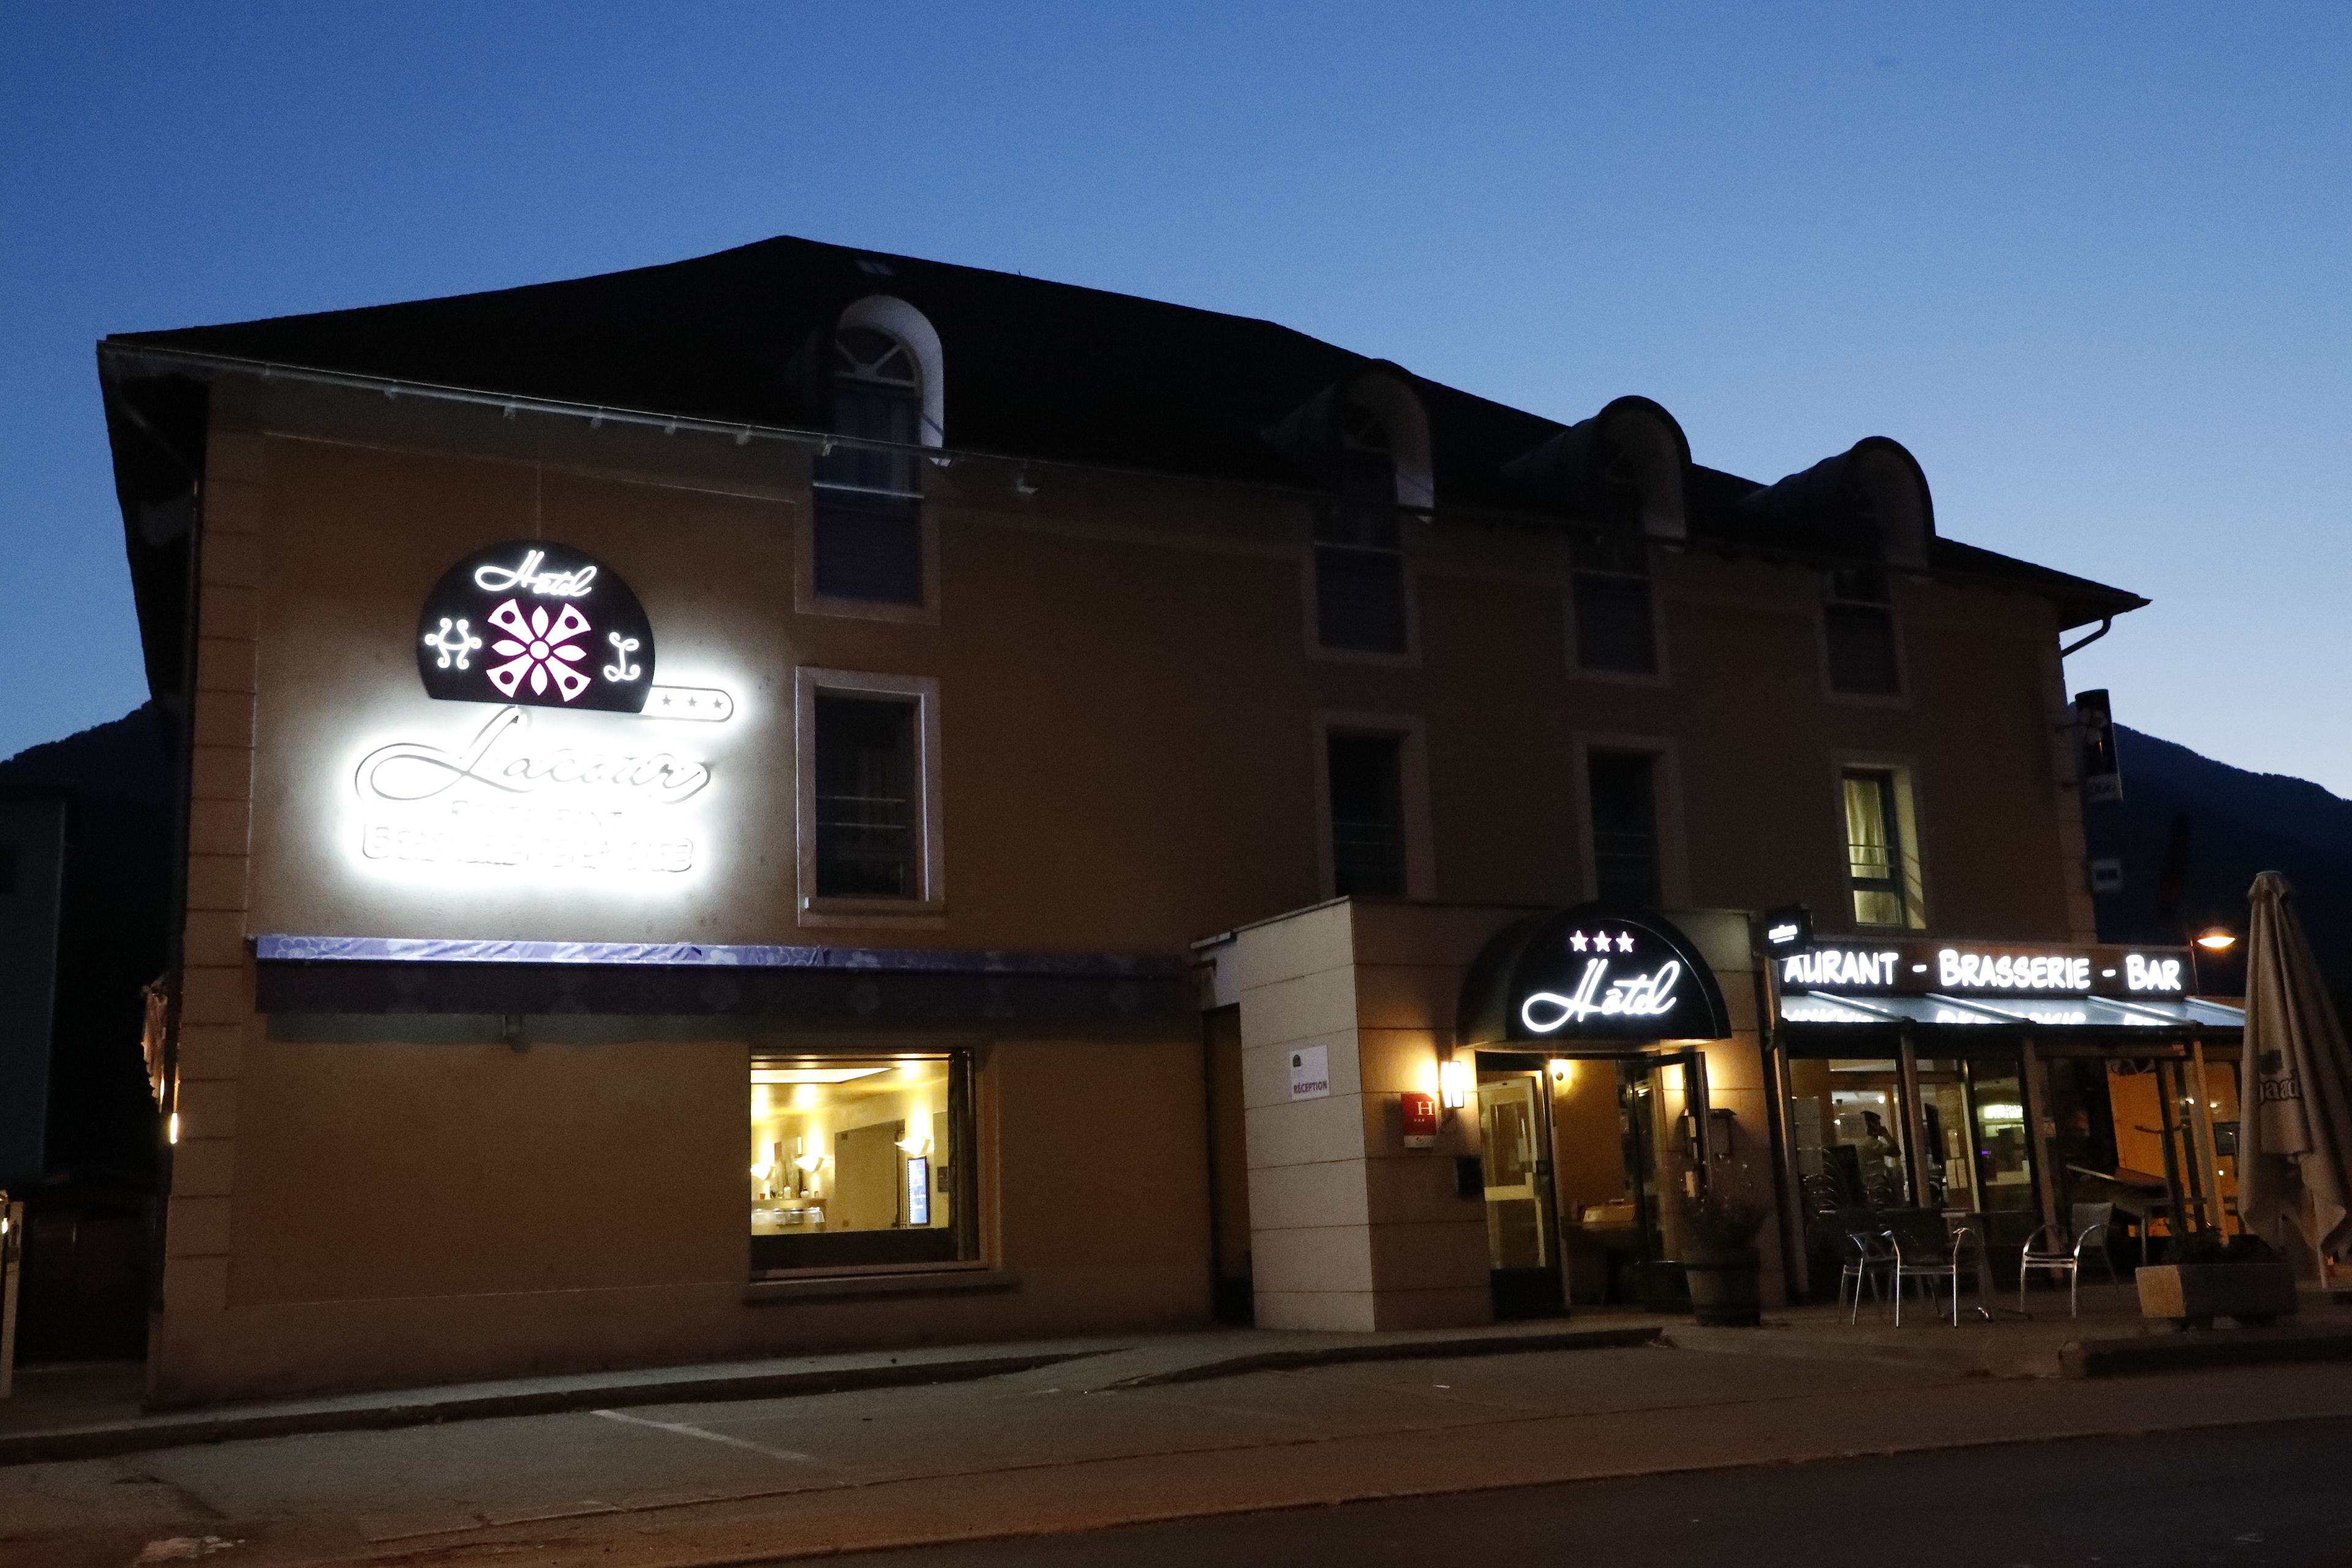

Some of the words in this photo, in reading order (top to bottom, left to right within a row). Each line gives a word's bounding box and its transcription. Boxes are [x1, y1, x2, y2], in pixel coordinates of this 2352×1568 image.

[1939, 949, 2090, 989] BRASSERIE
[2126, 954, 2181, 990] BAR
[1293, 1080, 1328, 1094] RÉCEPTION
[1416, 1101, 1434, 1115] H
